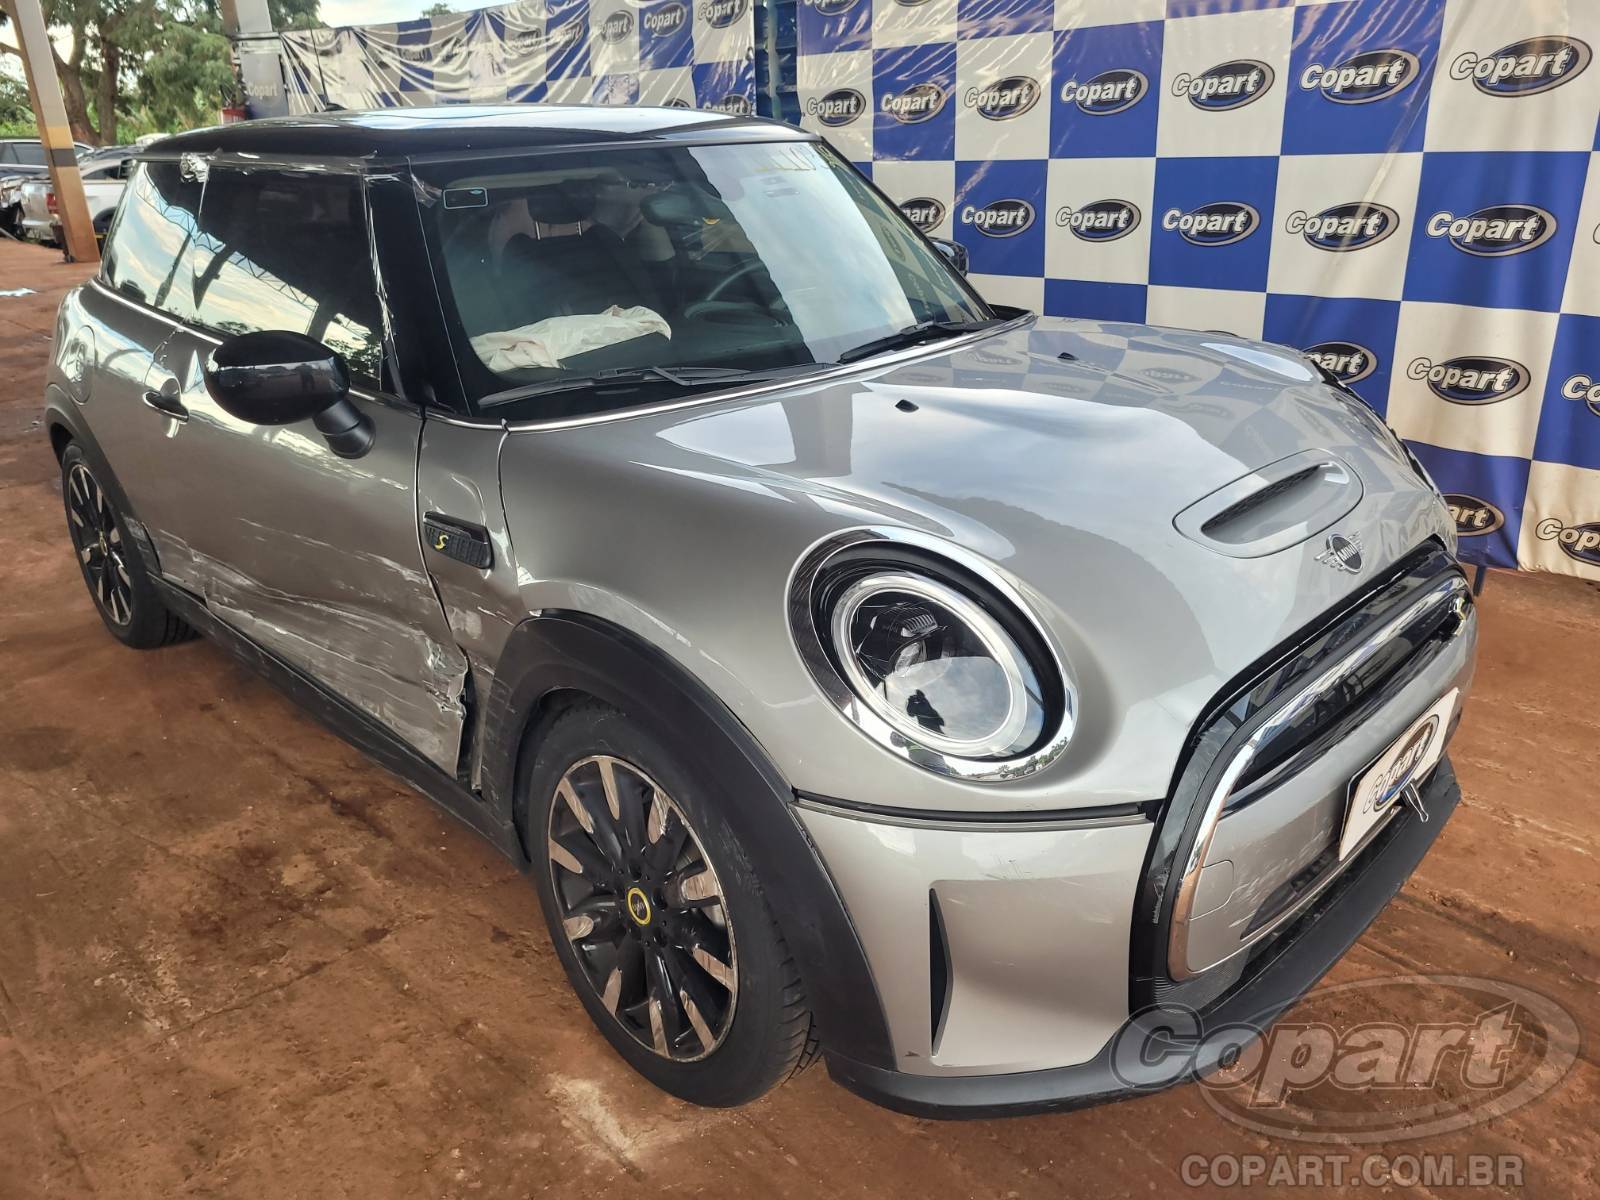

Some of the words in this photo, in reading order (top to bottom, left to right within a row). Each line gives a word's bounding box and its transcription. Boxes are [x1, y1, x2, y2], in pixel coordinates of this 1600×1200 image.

[644, 7, 681, 33] Copart
[1300, 54, 1406, 94] Copart
[1450, 44, 1573, 86] Copart
[964, 82, 1035, 116] Copart
[1061, 75, 1138, 107] Copart
[1171, 66, 1261, 101] Copart
[807, 94, 858, 117] Copart
[881, 85, 938, 118] Copart
[961, 202, 1027, 229] Copart
[1055, 205, 1130, 231] Copart
[1162, 207, 1248, 235] Copart
[1285, 210, 1383, 240] Copart
[1426, 209, 1540, 244] Copart
[1406, 357, 1514, 392] Copart
[434, 534, 449, 549] S
[1535, 517, 1600, 553] Cop
